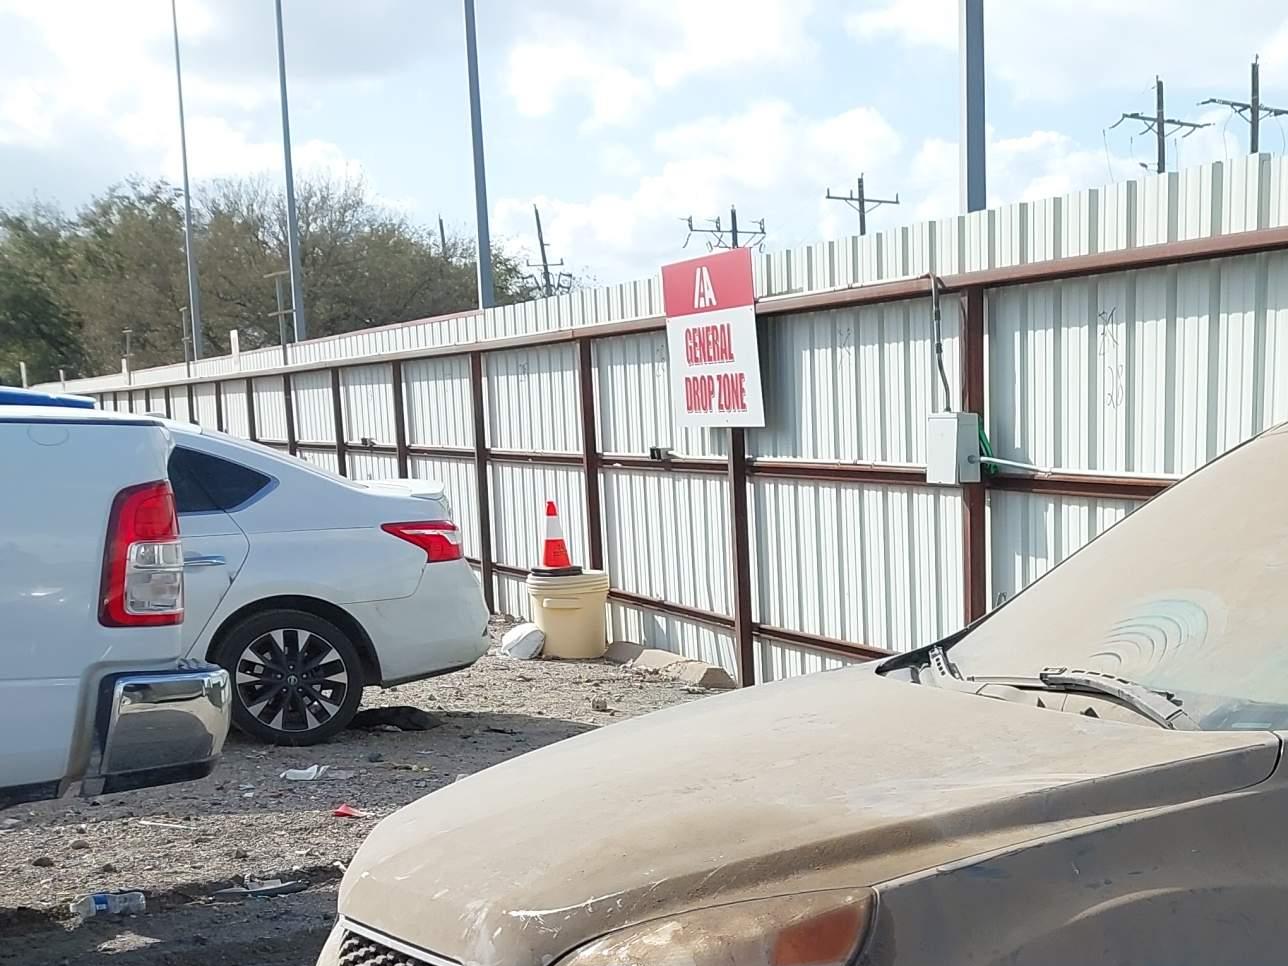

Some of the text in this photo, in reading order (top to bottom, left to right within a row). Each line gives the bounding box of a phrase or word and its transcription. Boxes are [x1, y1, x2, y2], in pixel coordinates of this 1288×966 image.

[684, 322, 735, 366] GENERAL
[684, 372, 748, 413] DROP ZONE
